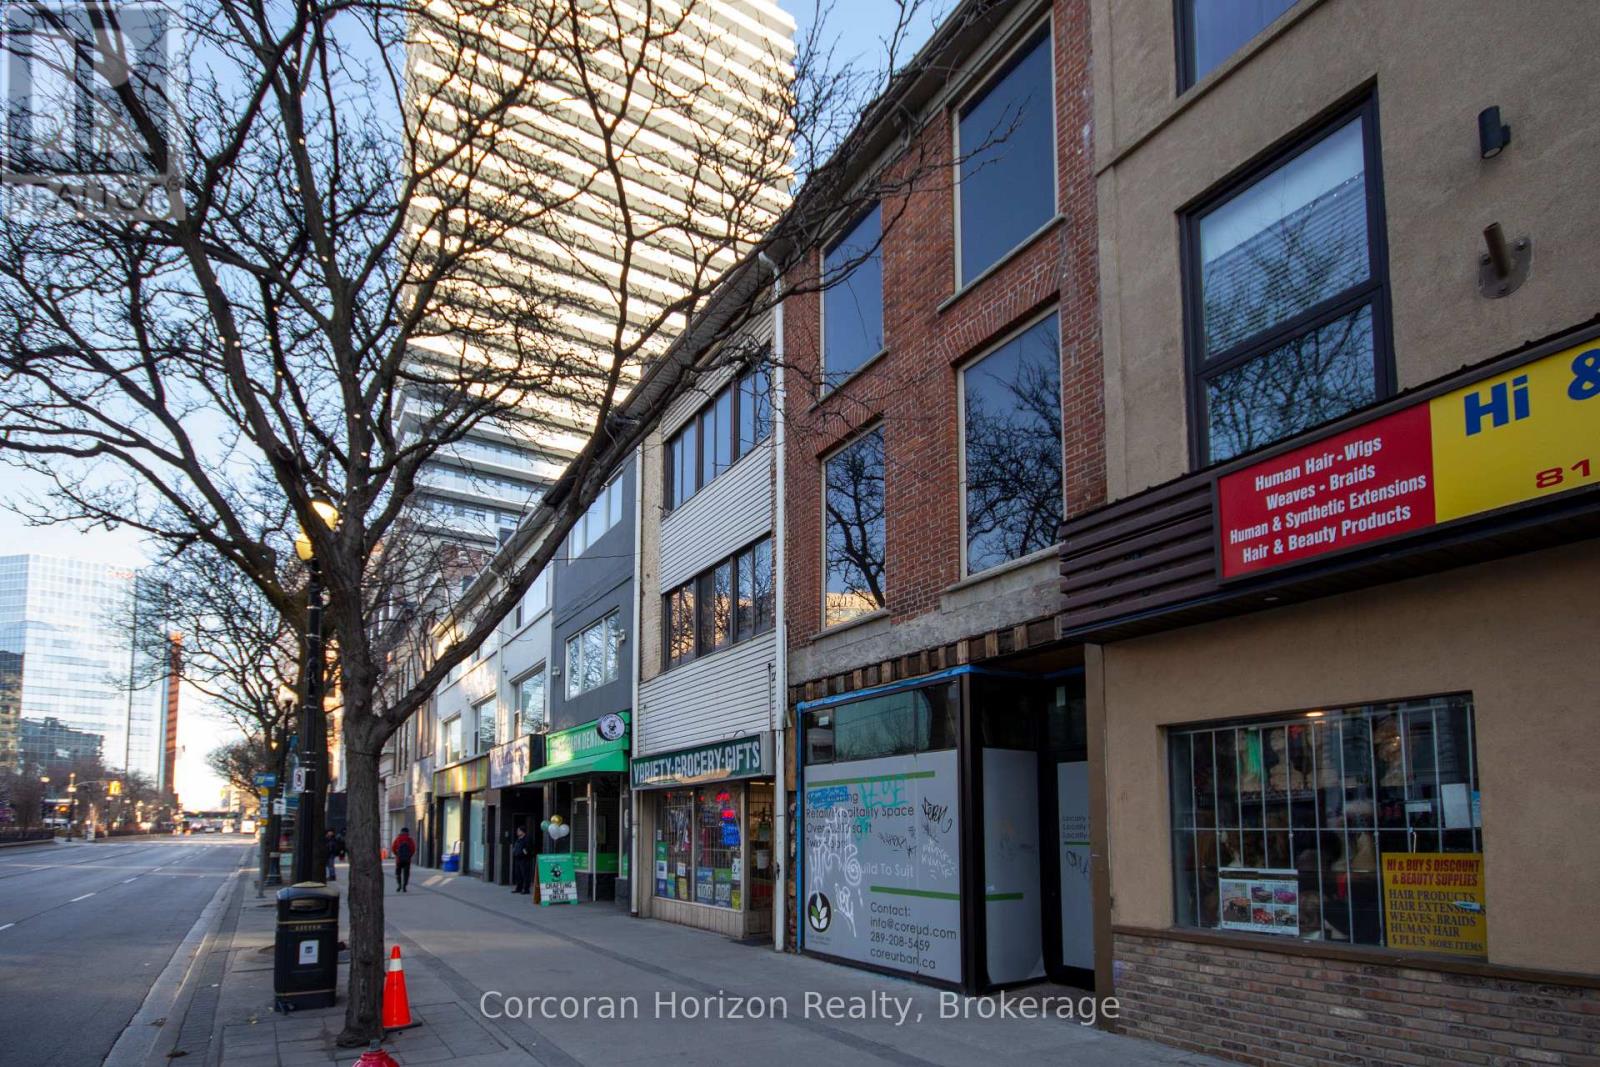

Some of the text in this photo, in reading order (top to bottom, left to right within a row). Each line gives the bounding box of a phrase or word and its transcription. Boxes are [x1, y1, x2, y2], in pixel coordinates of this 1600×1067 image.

[1464, 374, 1530, 437] Hi
[1255, 465, 1301, 491] Human
[1536, 458, 1591, 489] 81
[1266, 464, 1376, 510] Weaves Braids
[1230, 474, 1427, 544] Human & Synthetic Extensions
[1243, 505, 1412, 563] Hair & Beauty Products
[633, 740, 760, 784] VARIETY GROCERY GIFTS
[881, 806, 915, 819] Space
[880, 863, 893, 876] To
[895, 863, 914, 878] Suit
[1435, 860, 1480, 873] DISCOUNT
[1401, 873, 1435, 886] BEAUTY
[1437, 873, 1478, 887] SUPPLIES
[1390, 889, 1476, 902] HAIR PRODUCTS
[1391, 901, 1415, 912] HAIR
[870, 901, 911, 917] Contact:
[870, 918, 957, 941] info@coreud.com
[870, 932, 931, 952] 289-208-5459
[870, 948, 936, 971] coreurban.ca
